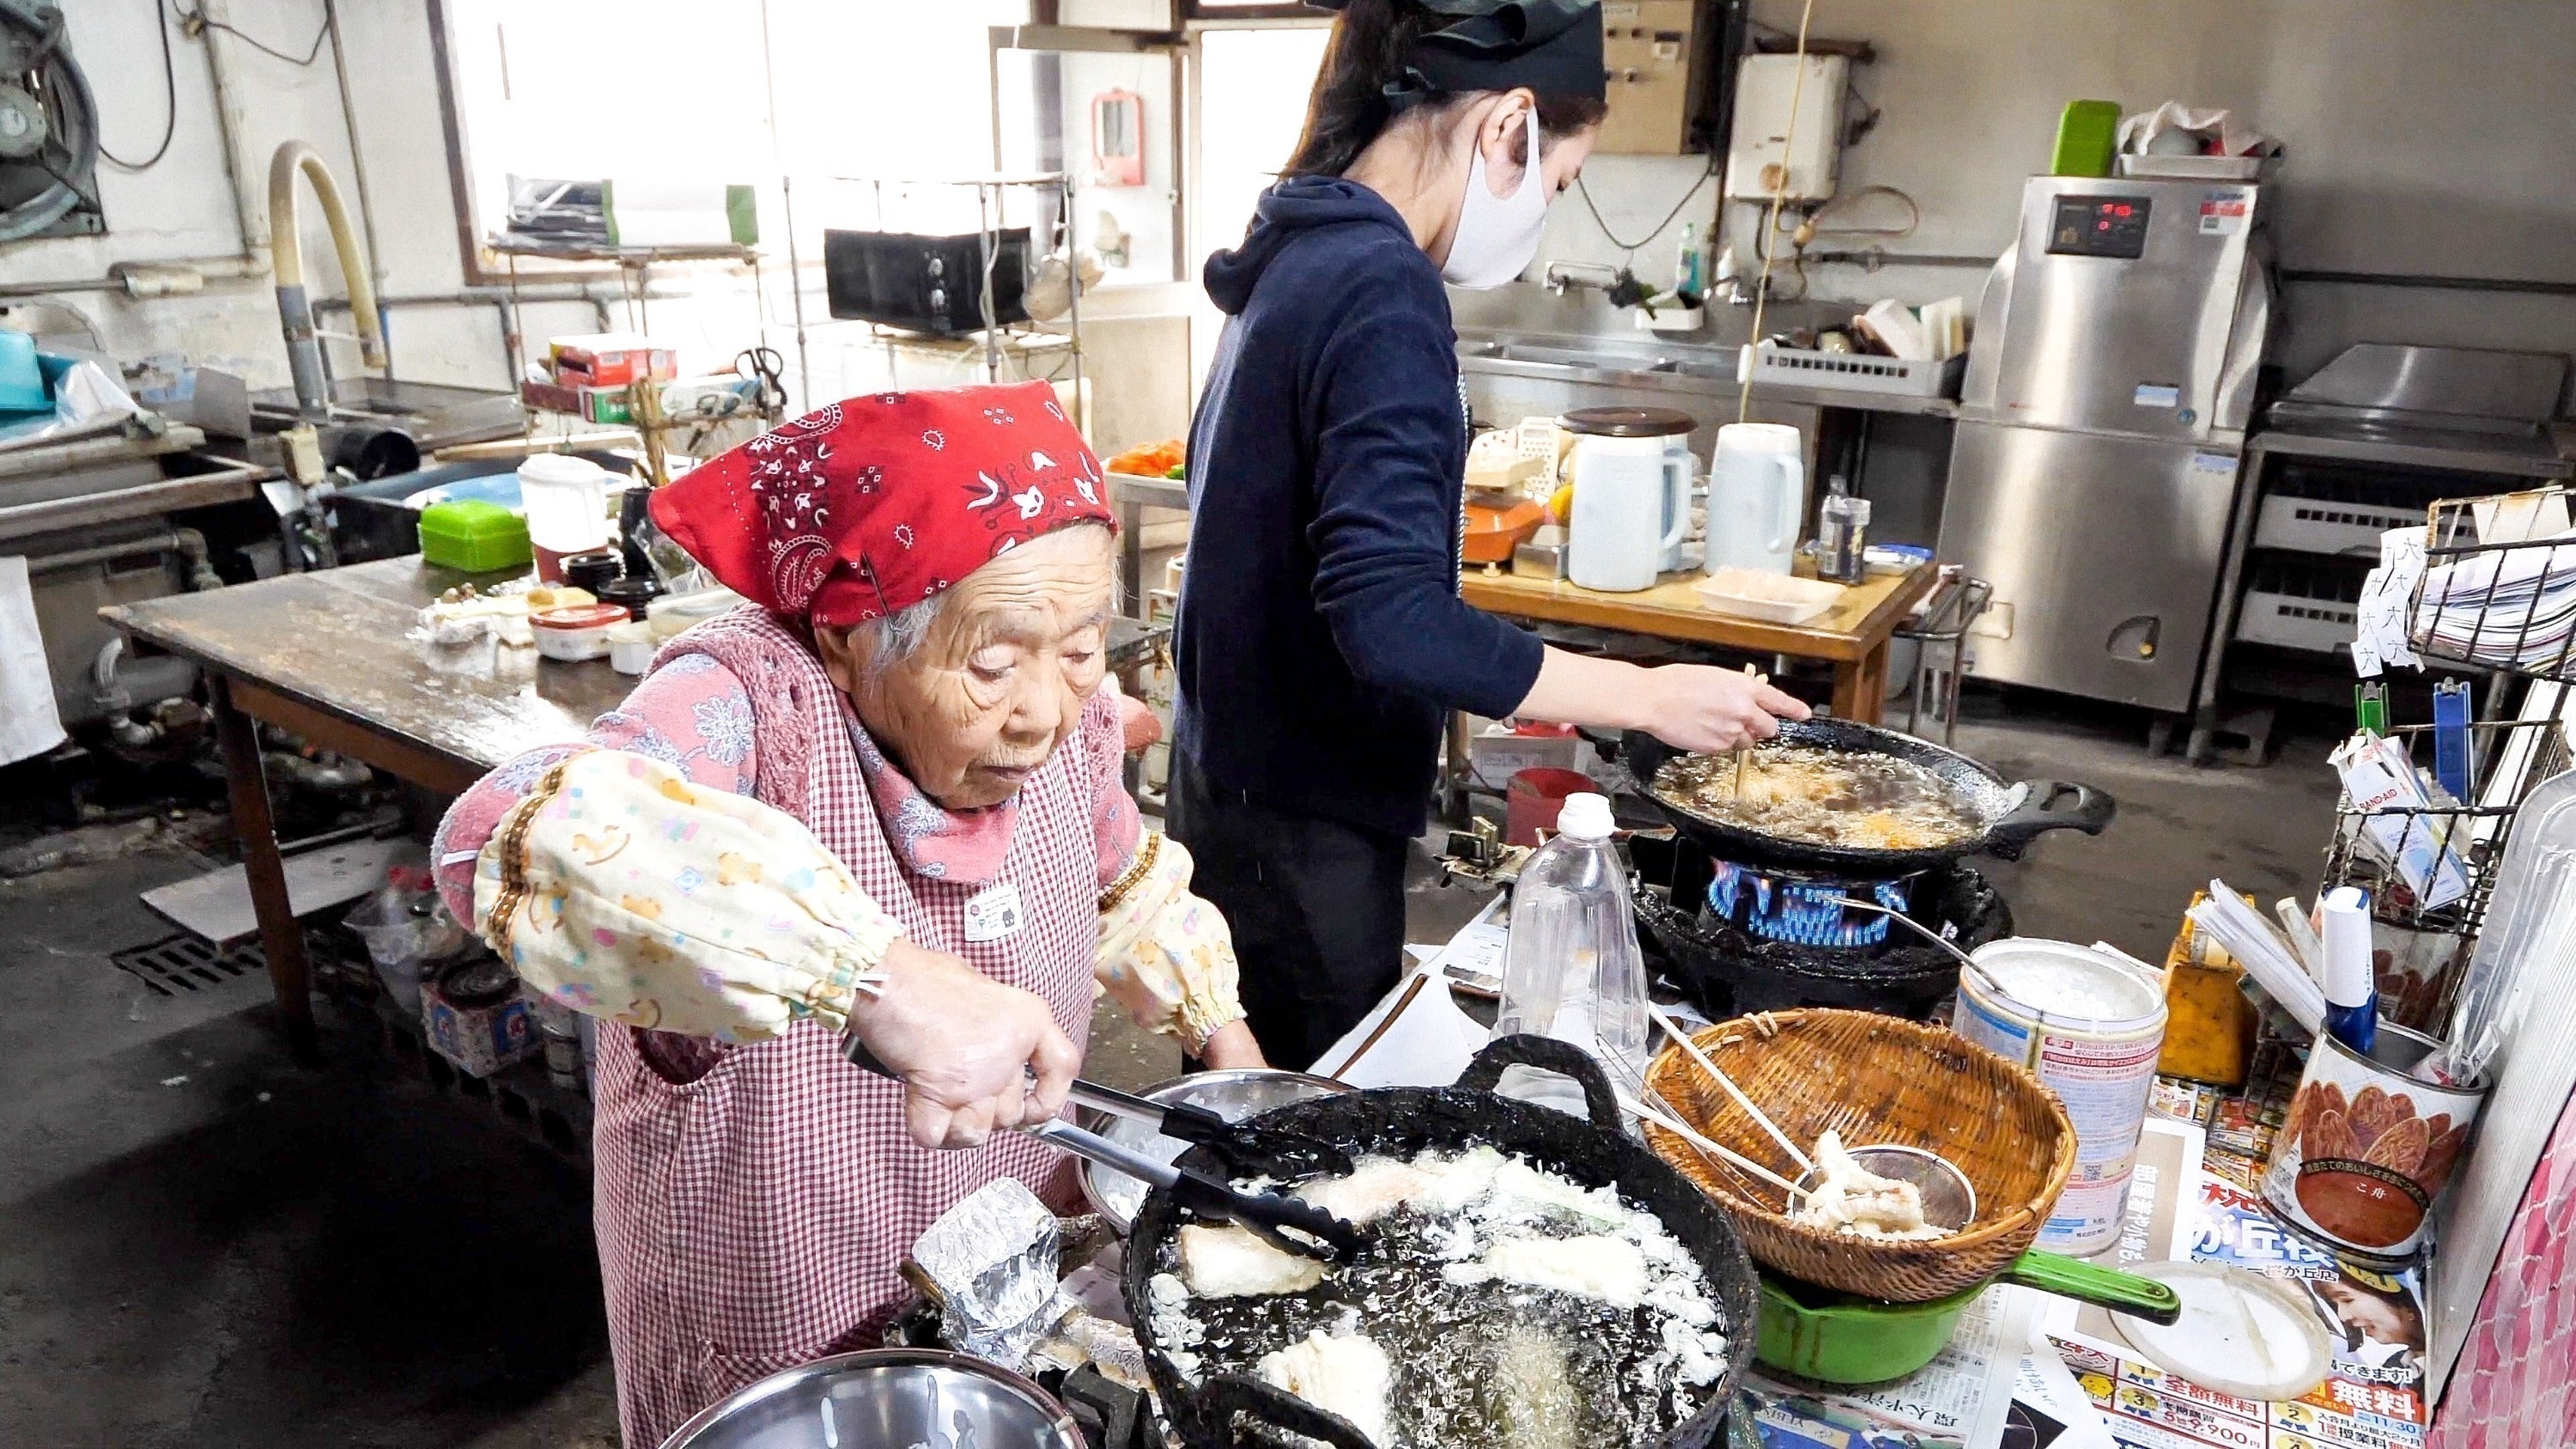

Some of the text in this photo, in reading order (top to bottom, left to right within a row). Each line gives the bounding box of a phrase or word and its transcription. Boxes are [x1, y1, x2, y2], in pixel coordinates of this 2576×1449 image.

[2397, 538, 2421, 560] 大
[2384, 574, 2408, 594] 大
[2360, 612, 2375, 636] 大
[2383, 606, 2401, 628] 大
[2360, 648, 2380, 671] 大
[2134, 1391, 2145, 1406] 3
[2330, 1379, 2416, 1422] 無料
[2287, 1409, 2301, 1421] 2
